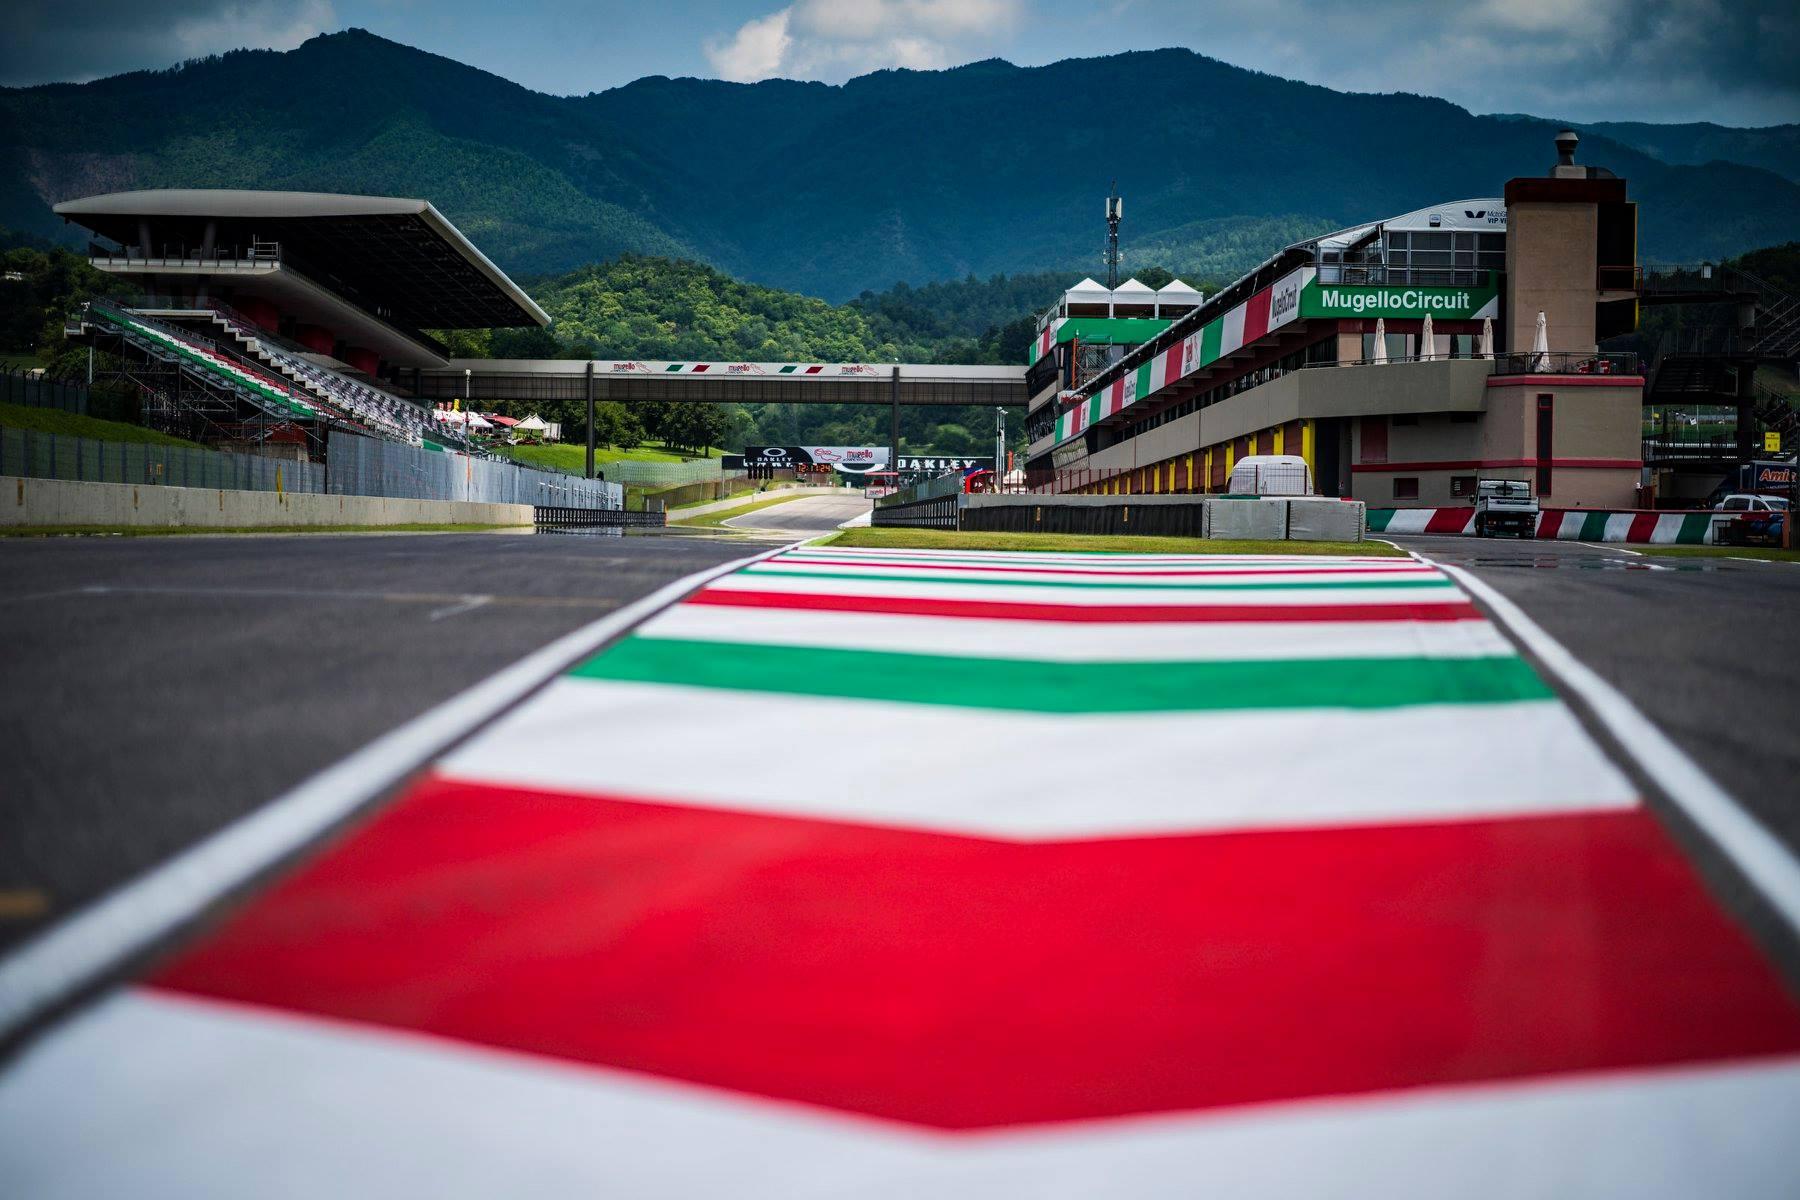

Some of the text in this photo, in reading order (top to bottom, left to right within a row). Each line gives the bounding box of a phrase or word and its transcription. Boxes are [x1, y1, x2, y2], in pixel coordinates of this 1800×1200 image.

[1322, 290, 1470, 312] MugelloCircuit
[613, 362, 636, 371] mugello
[728, 364, 750, 372] mugello
[842, 365, 864, 373] mugello
[846, 449, 873, 460] mugello
[898, 460, 975, 469] OAKLEY
